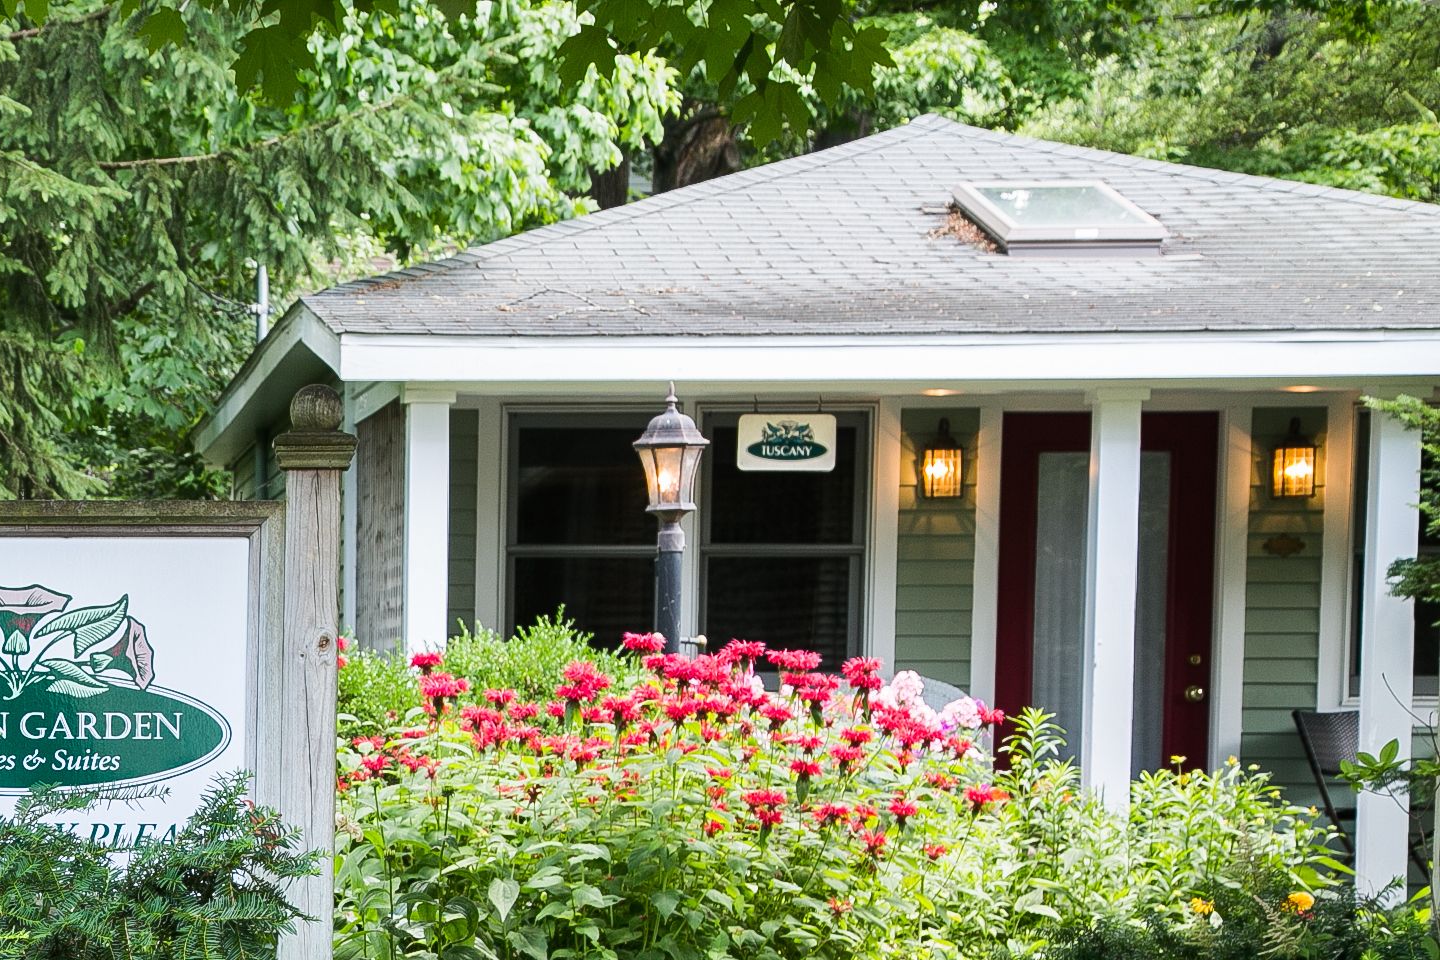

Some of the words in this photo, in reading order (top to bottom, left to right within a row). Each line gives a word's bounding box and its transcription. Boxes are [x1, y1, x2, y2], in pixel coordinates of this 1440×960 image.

[761, 444, 813, 457] TUSCANY
[19, 711, 183, 740] GARDEN
[22, 748, 46, 771] &
[51, 748, 121, 771] Suites
